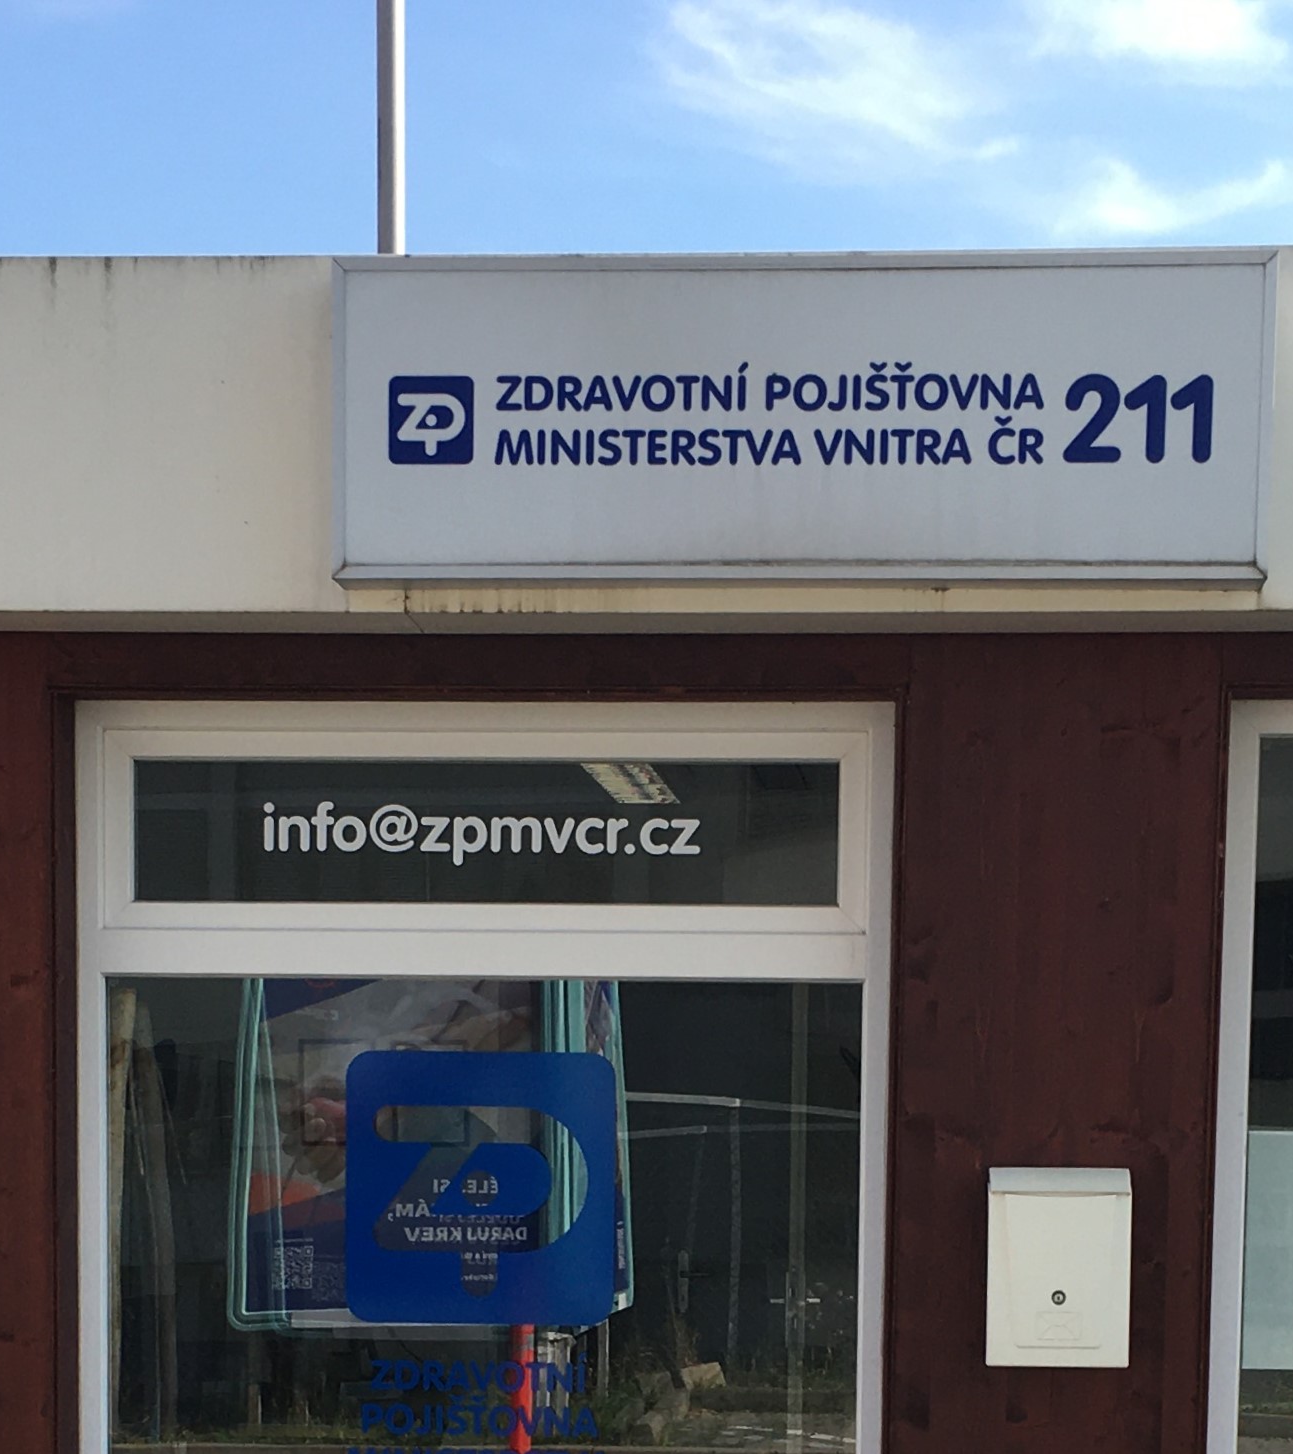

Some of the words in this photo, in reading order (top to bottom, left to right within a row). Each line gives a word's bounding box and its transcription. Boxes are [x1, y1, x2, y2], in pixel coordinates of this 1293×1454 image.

[494, 361, 750, 413] ZDRAVOTNÍ
[765, 361, 1045, 413] POJIŠŤOVNA
[493, 428, 802, 466] MINISTERSTVA
[813, 428, 972, 466] VNITRA
[987, 415, 1044, 466] ČR
[1062, 373, 1215, 464] 211
[261, 801, 701, 867] info@zpmvcr.cz
[370, 1351, 588, 1395] ZDRAVOTNÍ
[361, 1395, 600, 1439] POJIŠŤOVNA
